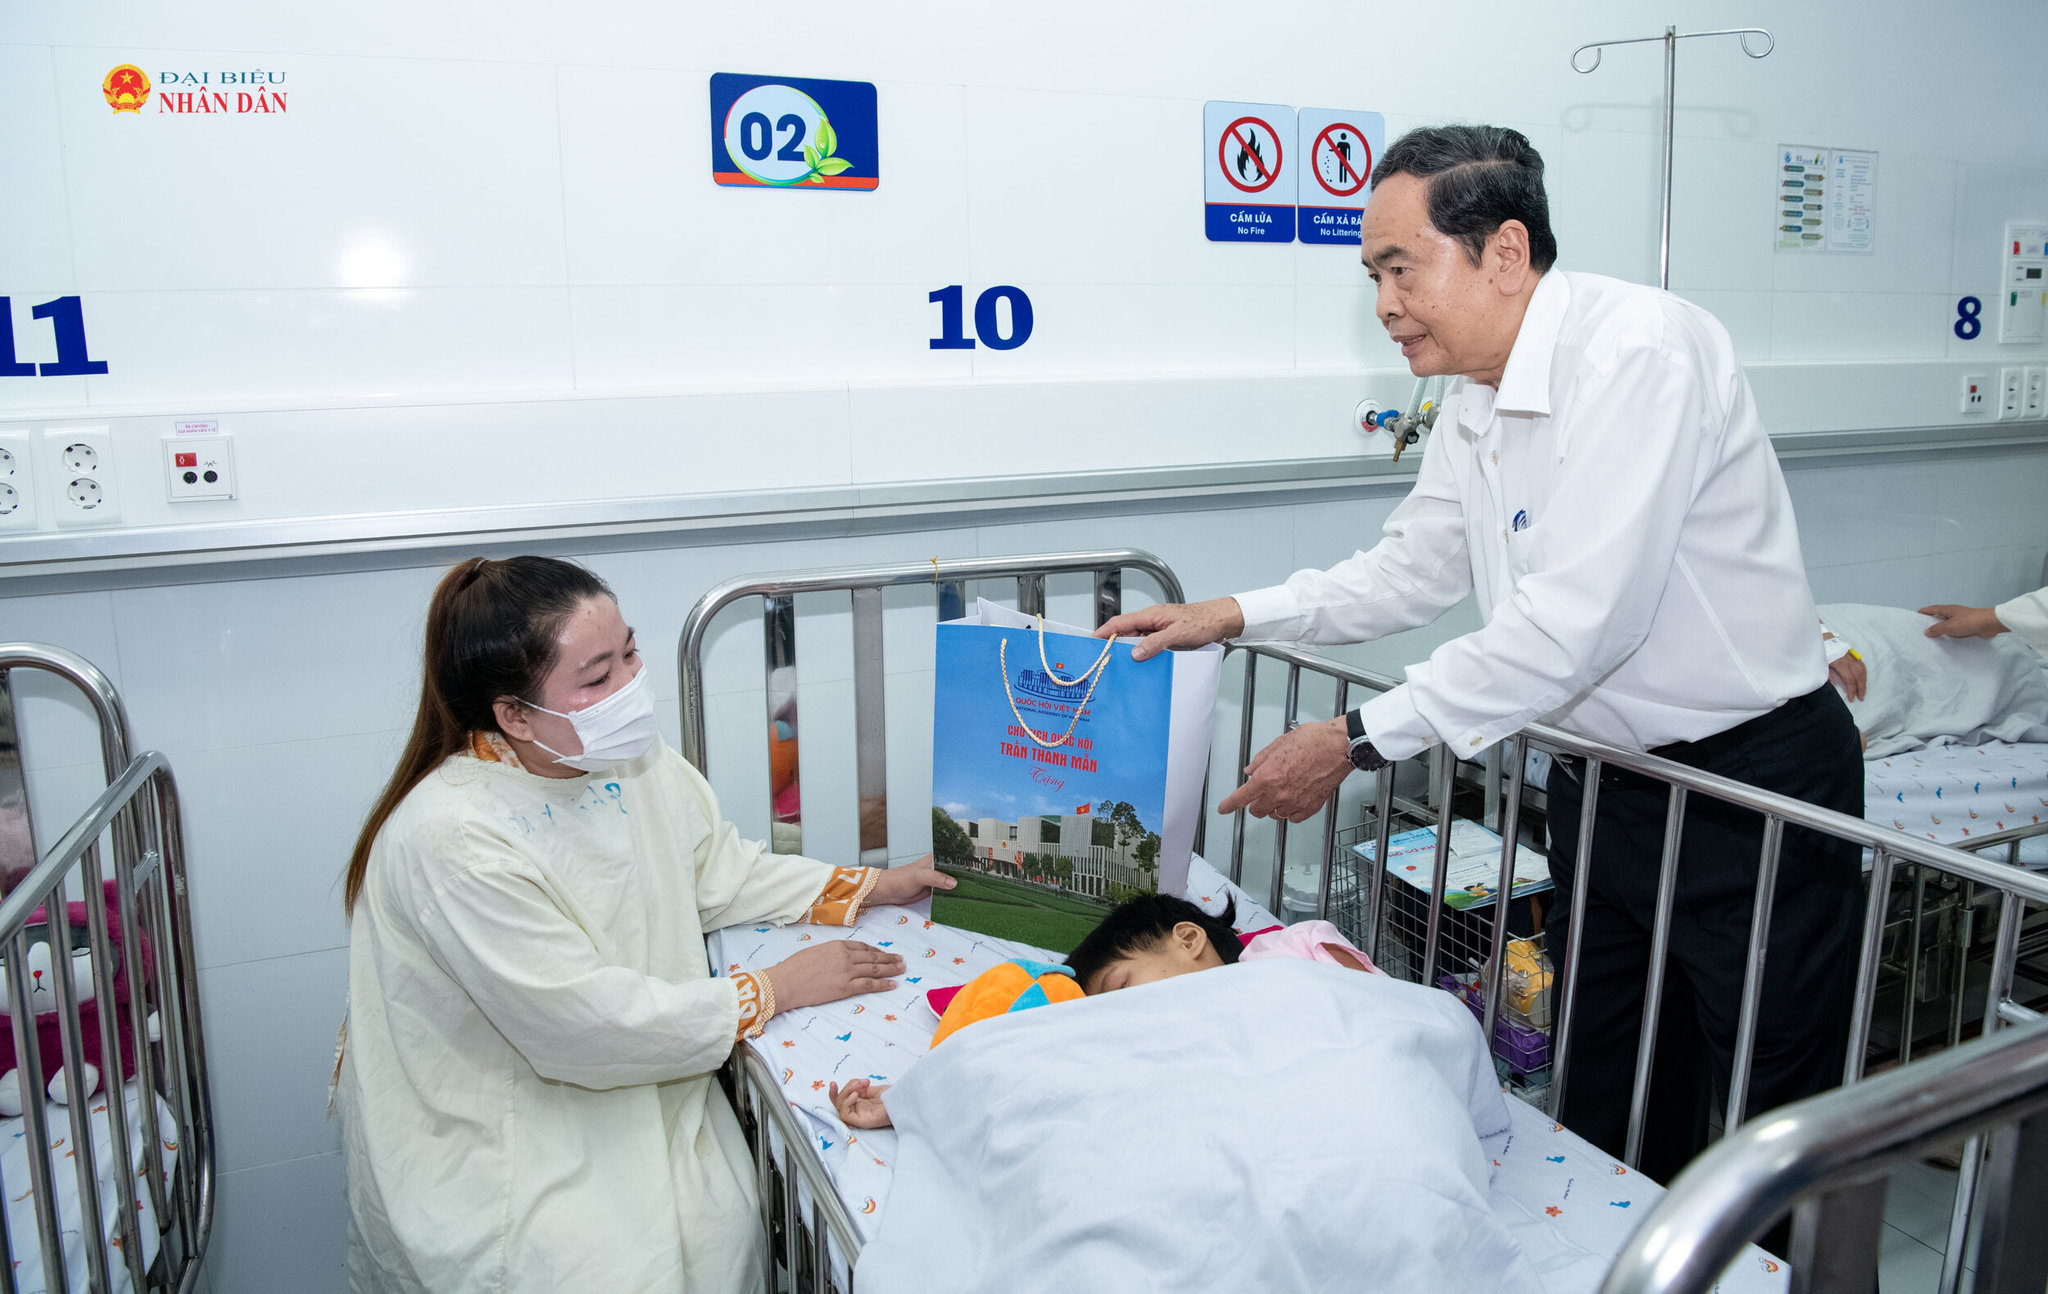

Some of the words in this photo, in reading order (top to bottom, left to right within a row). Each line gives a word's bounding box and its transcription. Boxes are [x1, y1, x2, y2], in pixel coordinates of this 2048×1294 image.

[740, 111, 807, 162] 02
[1229, 210, 1253, 223] CẤM
[1254, 212, 1273, 223] LỬA
[1313, 212, 1334, 224] CẤM
[1336, 213, 1349, 225] XẢ
[1350, 214, 1362, 226] RÁ
[1237, 226, 1249, 235] No
[1250, 226, 1265, 235] Fire
[1320, 228, 1331, 236] No
[1332, 228, 1362, 239] Littering
[928, 285, 1034, 350] 10
[1954, 296, 1982, 340] 8
[1015, 697, 1037, 707] QUỐC
[1038, 701, 1052, 710] HỘI
[1053, 703, 1070, 713] VIỆT
[1077, 737, 1094, 752] HỘI
[1000, 740, 1028, 759] TRẦN
[1031, 747, 1068, 767] THANH
[1029, 765, 1064, 792] Tặng
